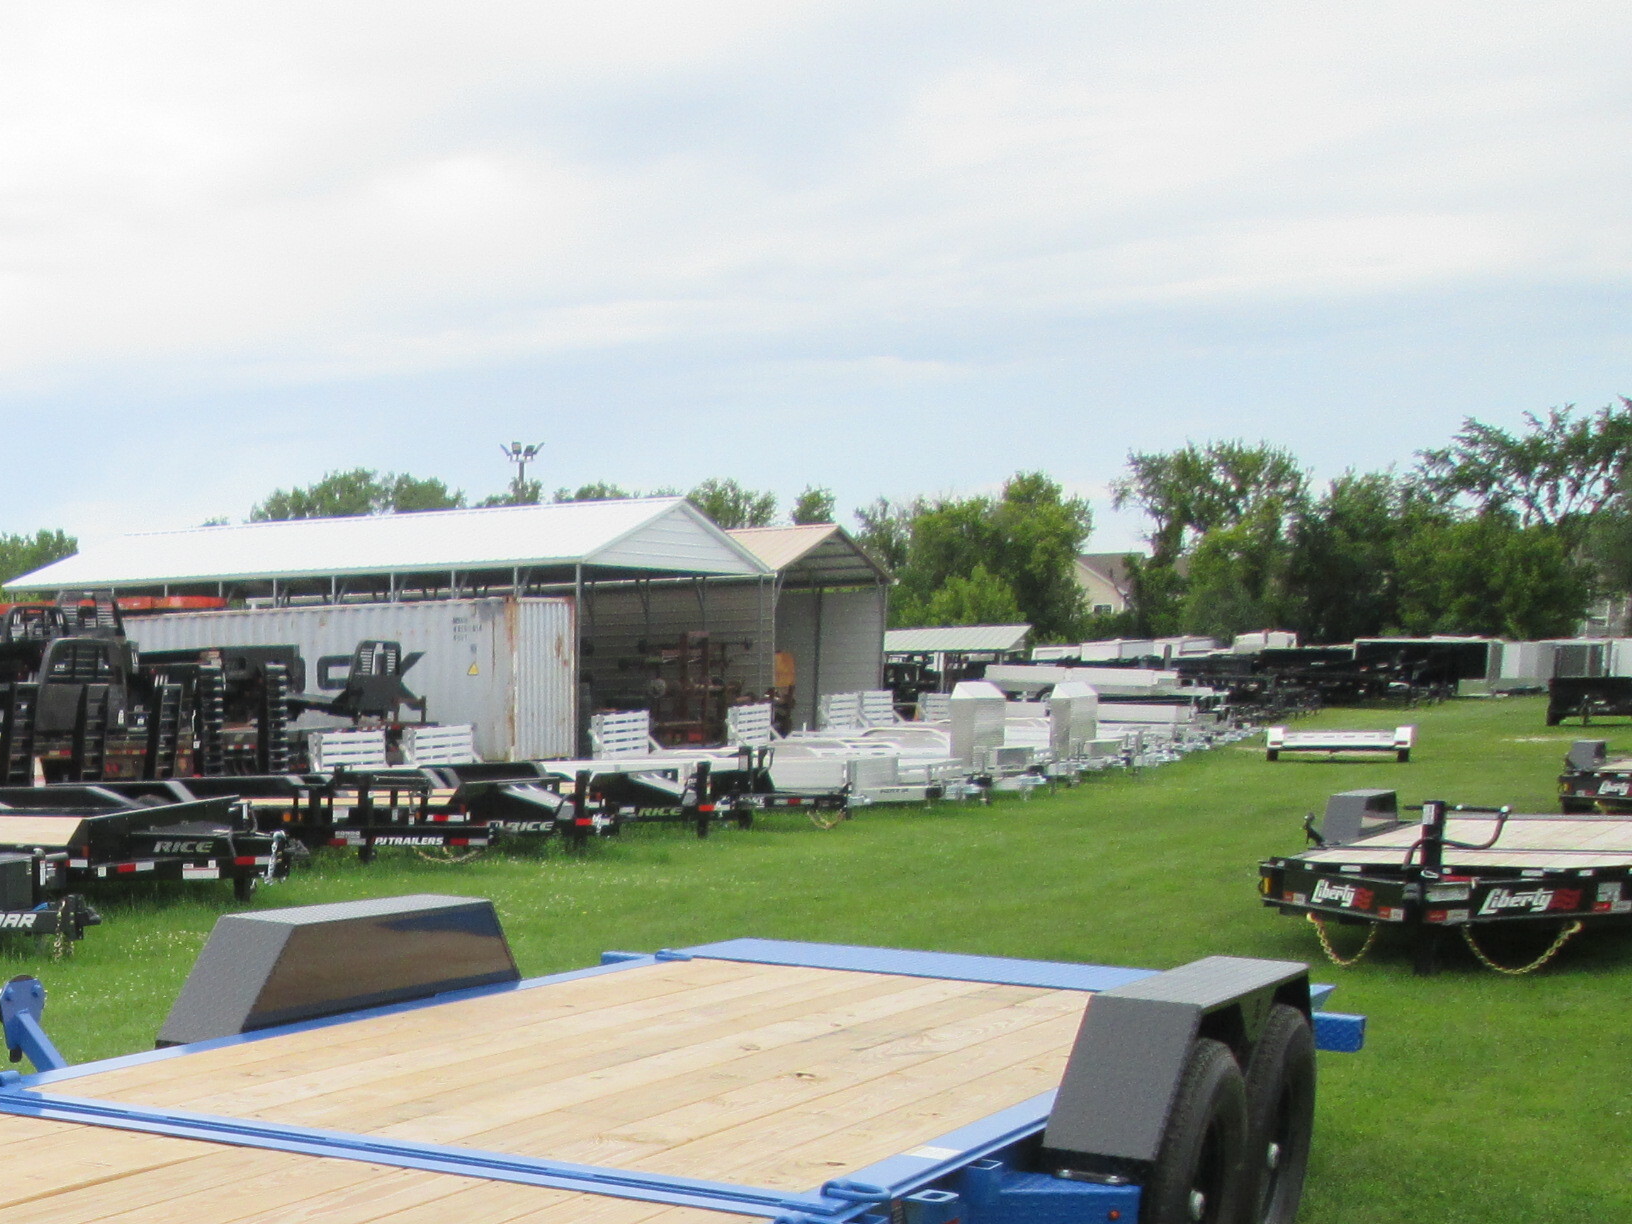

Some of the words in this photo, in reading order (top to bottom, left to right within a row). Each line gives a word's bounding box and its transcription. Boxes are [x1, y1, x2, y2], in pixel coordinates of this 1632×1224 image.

[152, 840, 215, 853] RICE
[388, 836, 444, 846] TRAILERS
[1311, 878, 1357, 908] Liberty
[1477, 887, 1555, 916] Liberty
